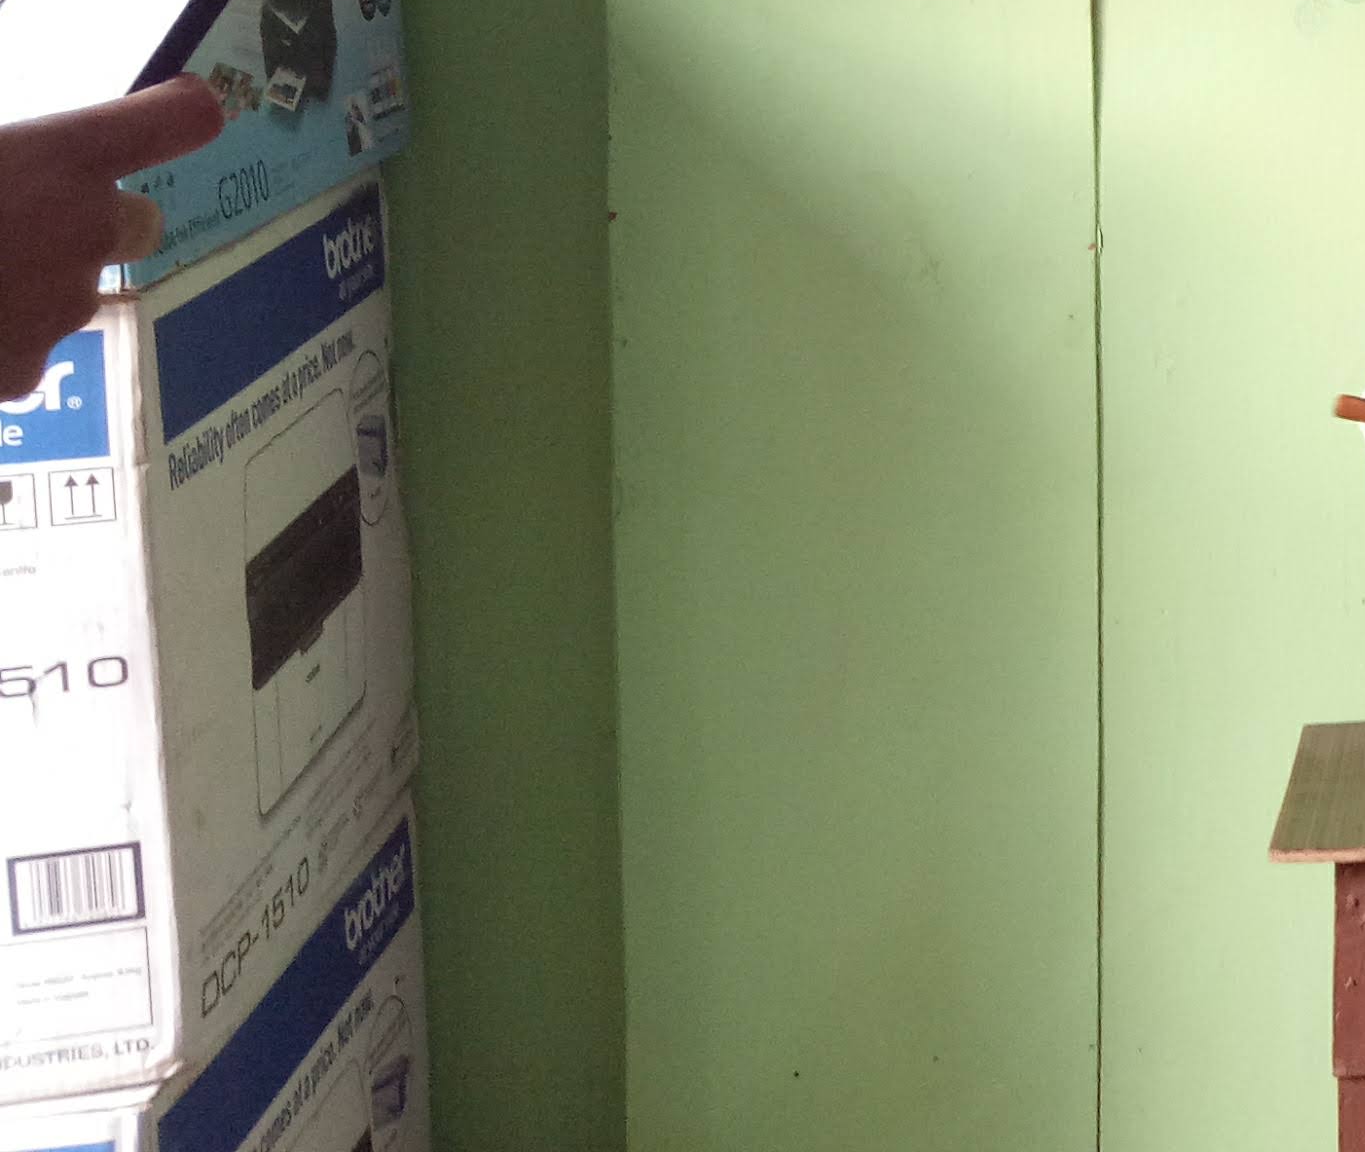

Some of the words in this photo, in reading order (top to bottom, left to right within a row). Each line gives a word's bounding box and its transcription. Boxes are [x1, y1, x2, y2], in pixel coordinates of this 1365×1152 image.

[218, 159, 270, 220] G2010
[168, 425, 224, 491] Reliability
[225, 408, 251, 449] often
[201, 856, 310, 1018] DCP-1510
[0, 1042, 109, 1072] DUSTRIES,
